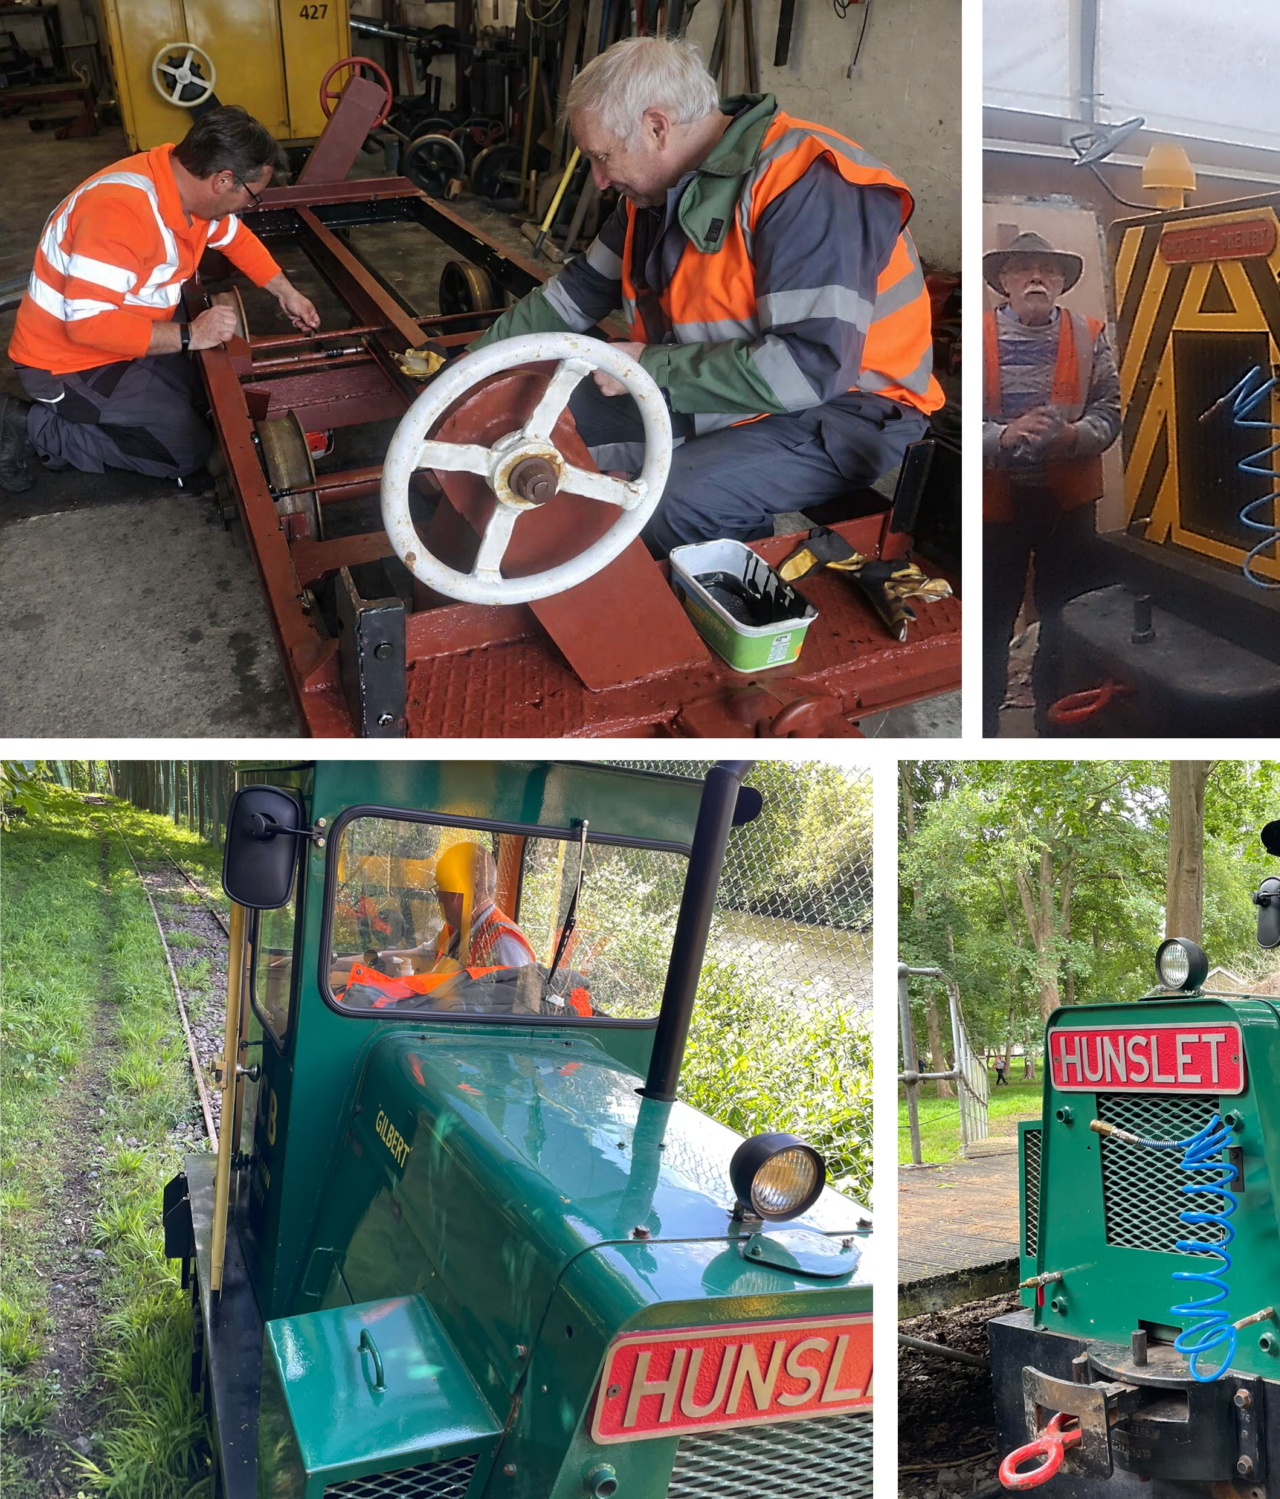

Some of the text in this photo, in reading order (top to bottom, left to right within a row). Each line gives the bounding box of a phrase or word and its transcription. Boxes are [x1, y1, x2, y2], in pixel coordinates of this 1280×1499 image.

[299, 4, 328, 20] 427
[1059, 1033, 1226, 1084] HUNSLET
[622, 1334, 874, 1428] HUNSL
